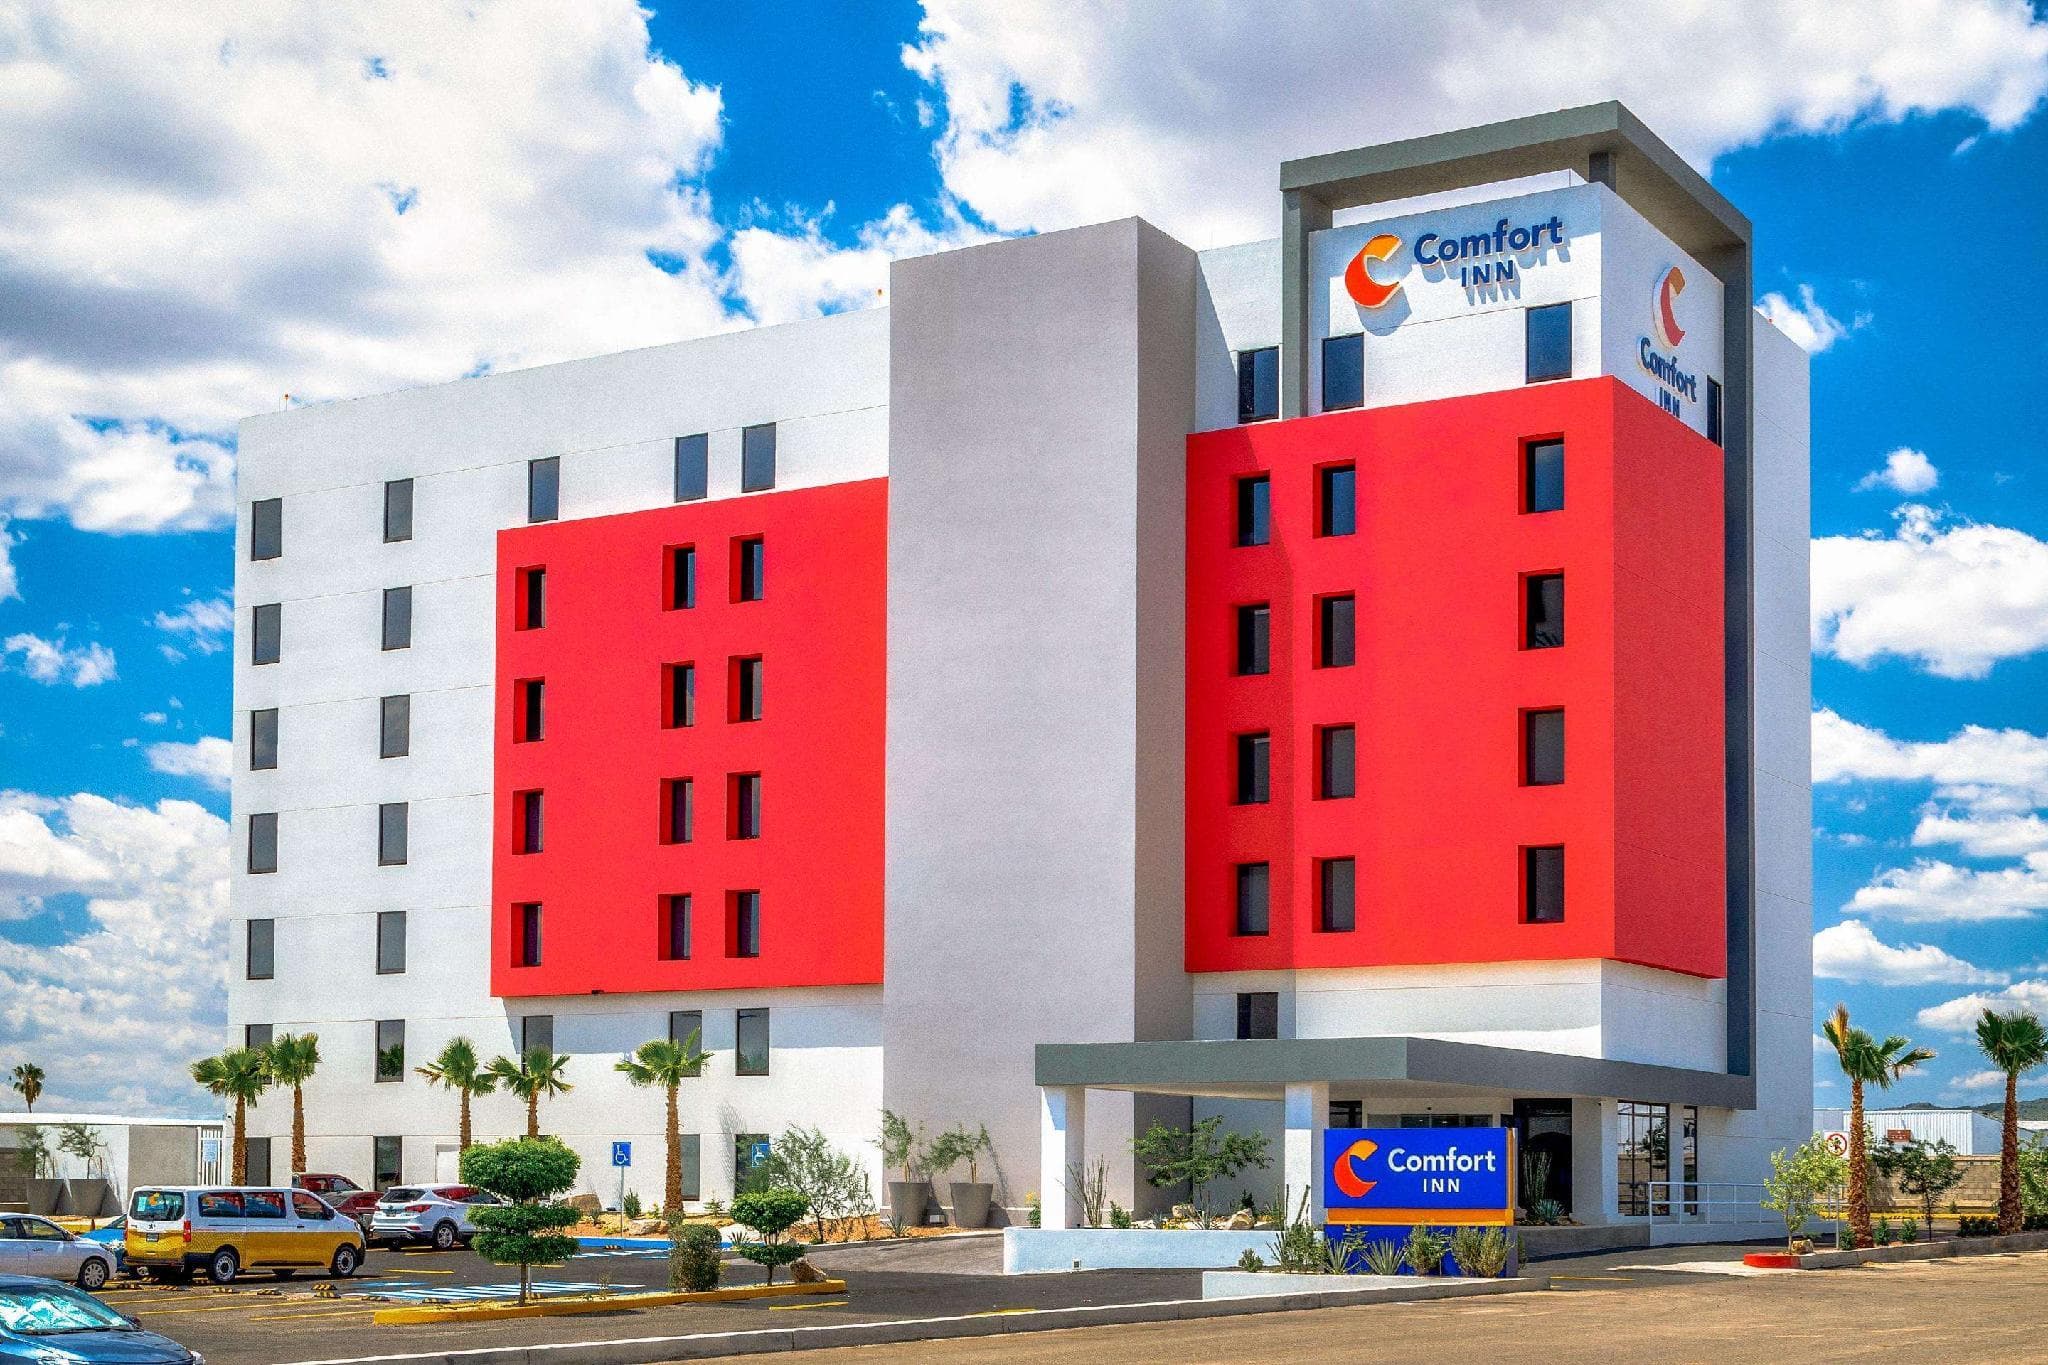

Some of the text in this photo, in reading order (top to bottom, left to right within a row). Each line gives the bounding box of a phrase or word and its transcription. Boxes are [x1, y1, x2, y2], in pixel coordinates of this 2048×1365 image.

[1413, 216, 1563, 265] Comfort
[1461, 259, 1514, 288] INN
[1640, 337, 1697, 403] Comfort
[1659, 386, 1680, 419] INN
[1387, 1146, 1496, 1172] Comfort
[1423, 1178, 1460, 1193] INN
